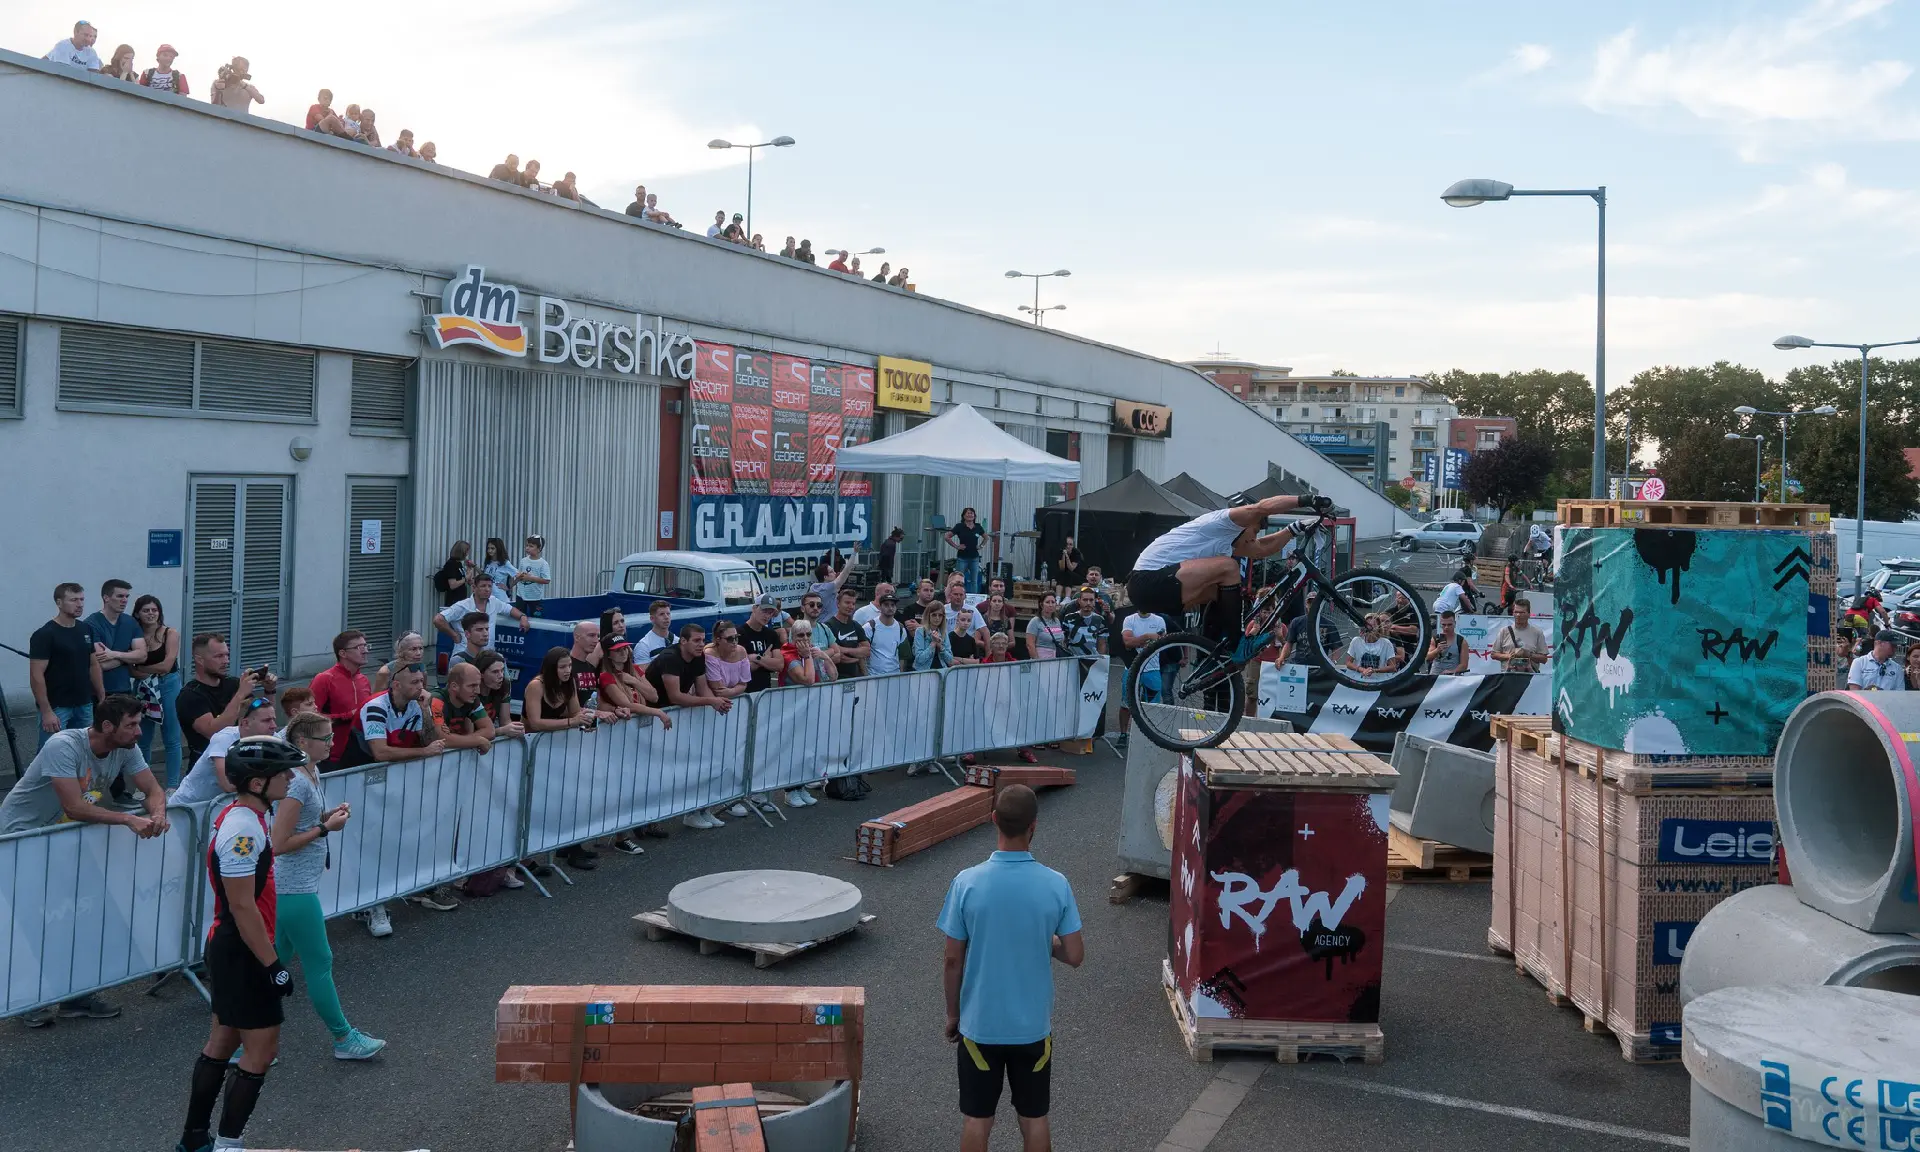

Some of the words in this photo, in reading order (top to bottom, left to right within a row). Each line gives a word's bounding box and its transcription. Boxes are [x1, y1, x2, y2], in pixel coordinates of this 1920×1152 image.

[454, 269, 517, 323] dm
[539, 296, 697, 380] Bershka
[692, 380, 729, 396] SPORT
[735, 374, 769, 388] GEORGE
[775, 390, 806, 405] SPORT
[811, 384, 841, 397] GEORGE
[774, 451, 805, 463] GEORGE
[735, 461, 767, 473] SPORT
[1446, 449, 1456, 480] JYSK
[695, 502, 868, 548] GRANDIS
[1560, 600, 1634, 661] RAW
[495, 634, 525, 645] NDIS
[1698, 626, 1778, 663] RAW
[1084, 691, 1103, 702] RAW
[1332, 703, 1359, 715] RAW
[1377, 706, 1406, 719] RAW
[1424, 708, 1453, 719] RAW
[1674, 826, 1773, 858] Leie
[1210, 868, 1368, 938] RAW
[1314, 934, 1351, 947] AGENCY
